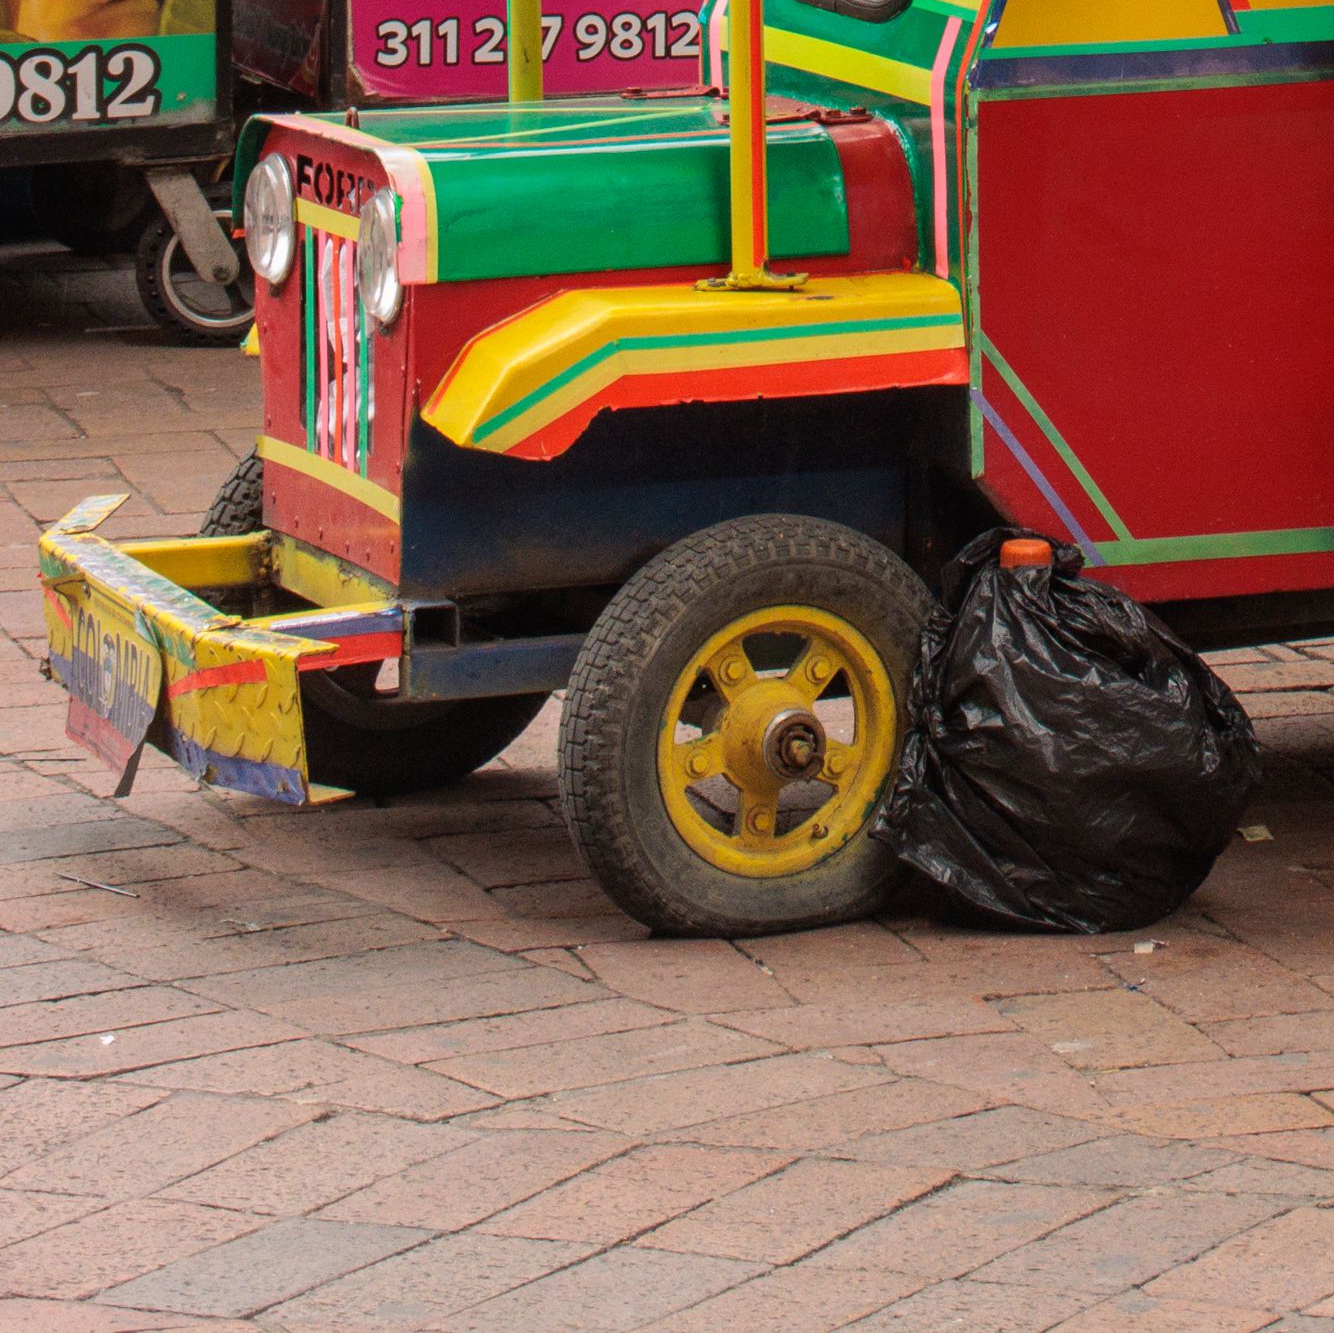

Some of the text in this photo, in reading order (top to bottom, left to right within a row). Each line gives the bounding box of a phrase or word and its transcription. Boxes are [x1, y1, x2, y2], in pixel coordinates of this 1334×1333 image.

[375, 10, 700, 67] 311 27 9812
